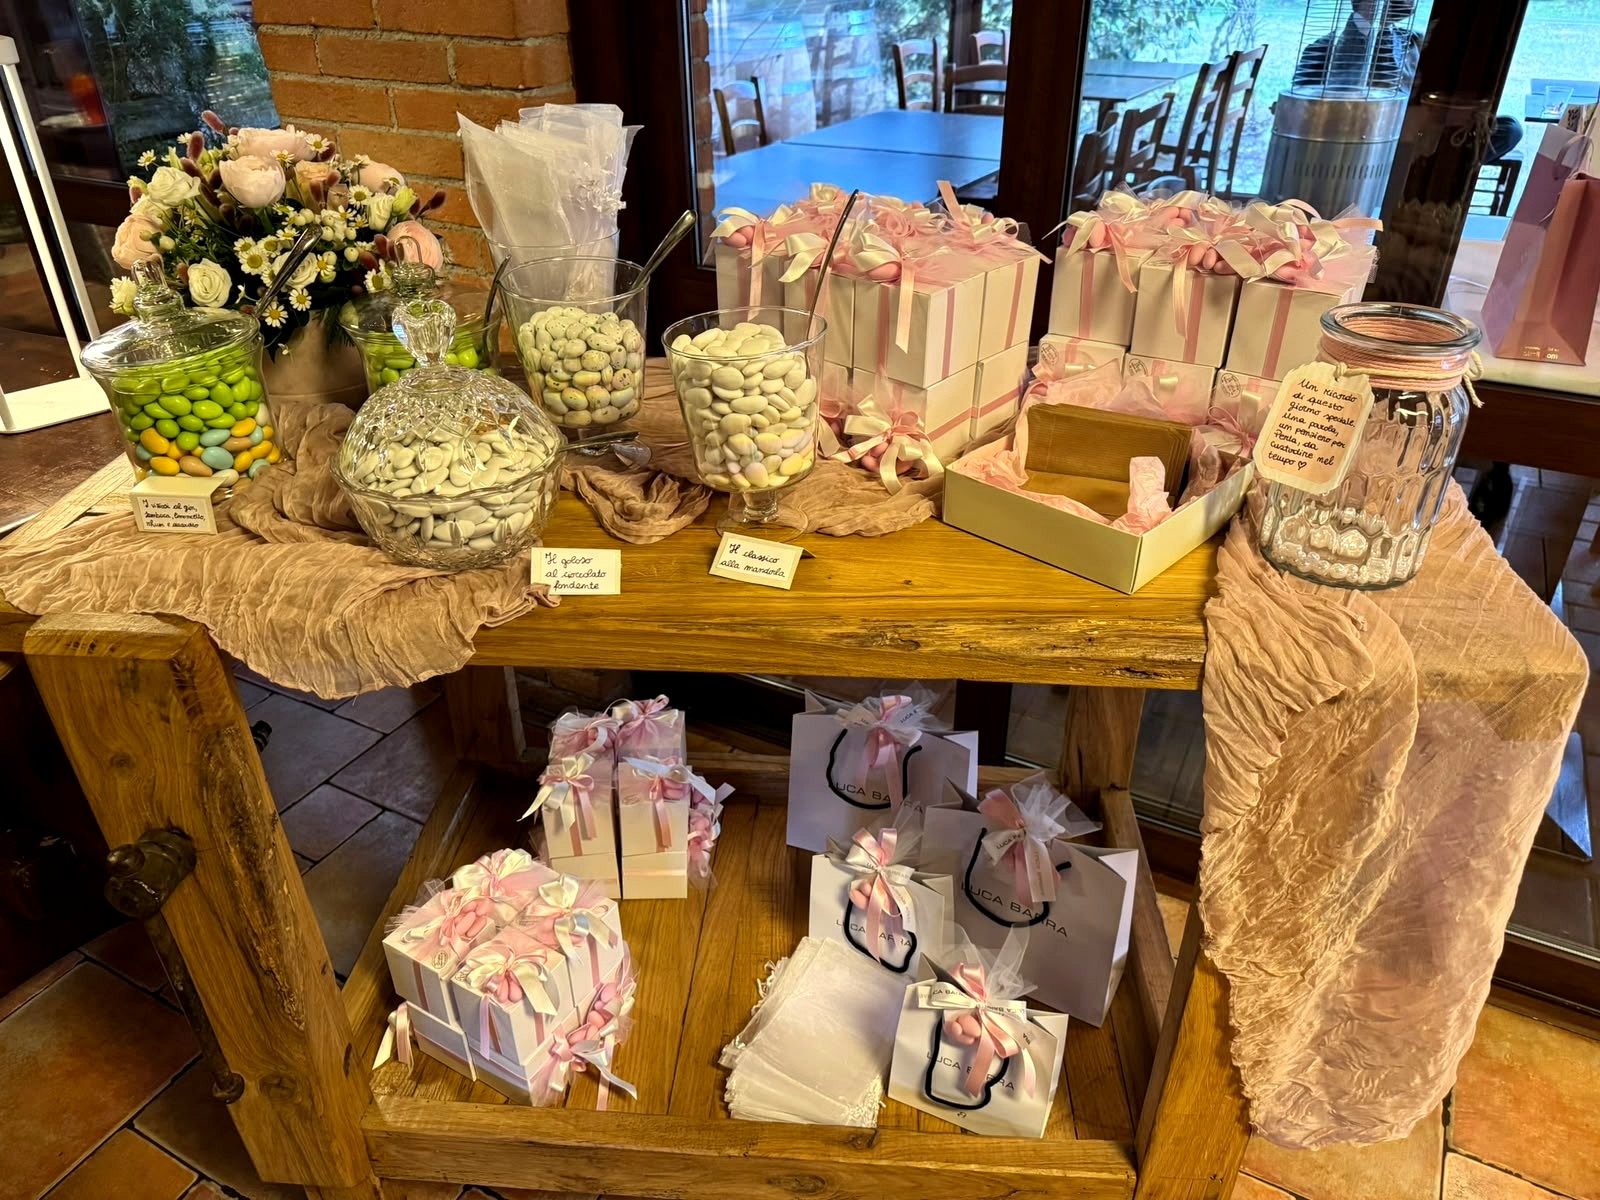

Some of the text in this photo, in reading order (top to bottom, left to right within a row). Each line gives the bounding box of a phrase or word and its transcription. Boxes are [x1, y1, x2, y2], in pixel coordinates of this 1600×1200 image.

[1298, 378, 1357, 403] Un ricordo
[1288, 401, 1321, 416] giorno
[1292, 392, 1344, 412] di questo
[1278, 422, 1346, 449] un pensiero per
[1302, 441, 1319, 451] da
[1268, 451, 1296, 466] tempo
[1316, 456, 1335, 466] nel
[545, 551, 593, 568] Il goloso
[729, 543, 780, 564] Il classico
[545, 568, 606, 578] al cioccolato
[720, 559, 786, 578] alla mandorla
[553, 580, 599, 592] fondente
[832, 782, 866, 797] UCA
[836, 919, 866, 933] LCA
